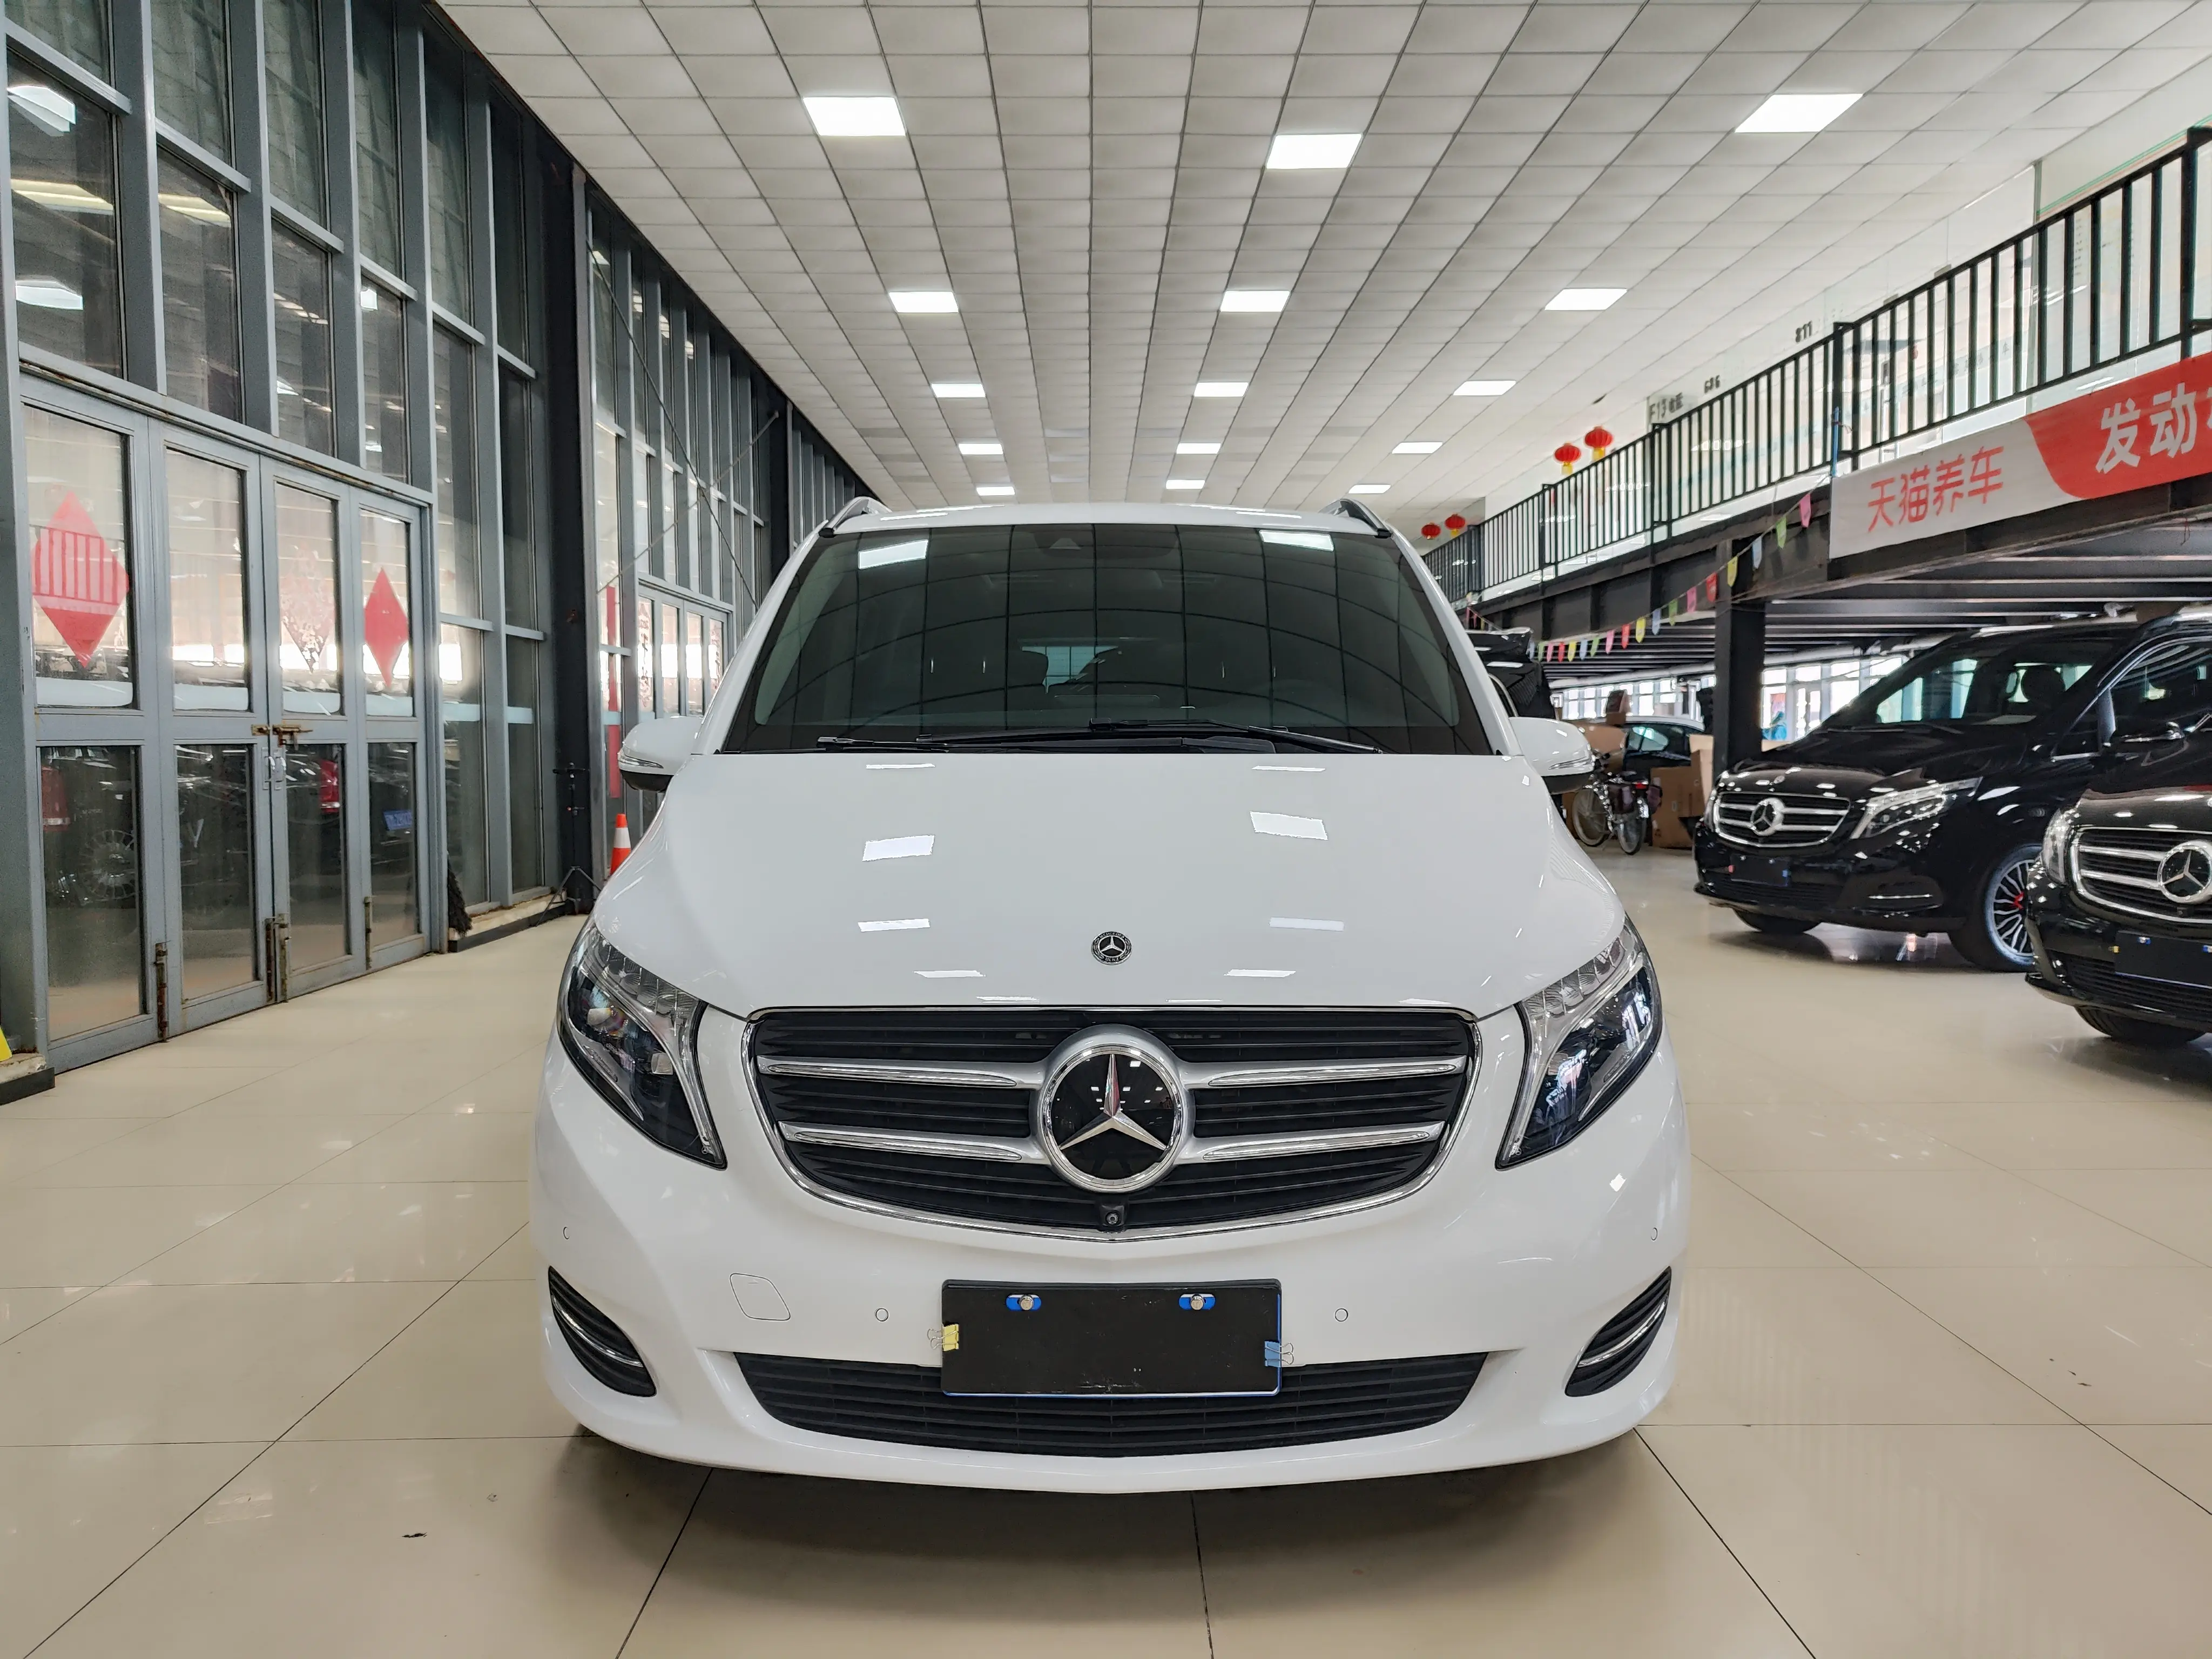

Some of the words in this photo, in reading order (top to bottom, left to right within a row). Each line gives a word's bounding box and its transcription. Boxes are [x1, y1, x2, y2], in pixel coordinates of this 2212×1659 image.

[2096, 382, 2212, 474] 发动
[1868, 446, 2004, 532] 天猫养车
